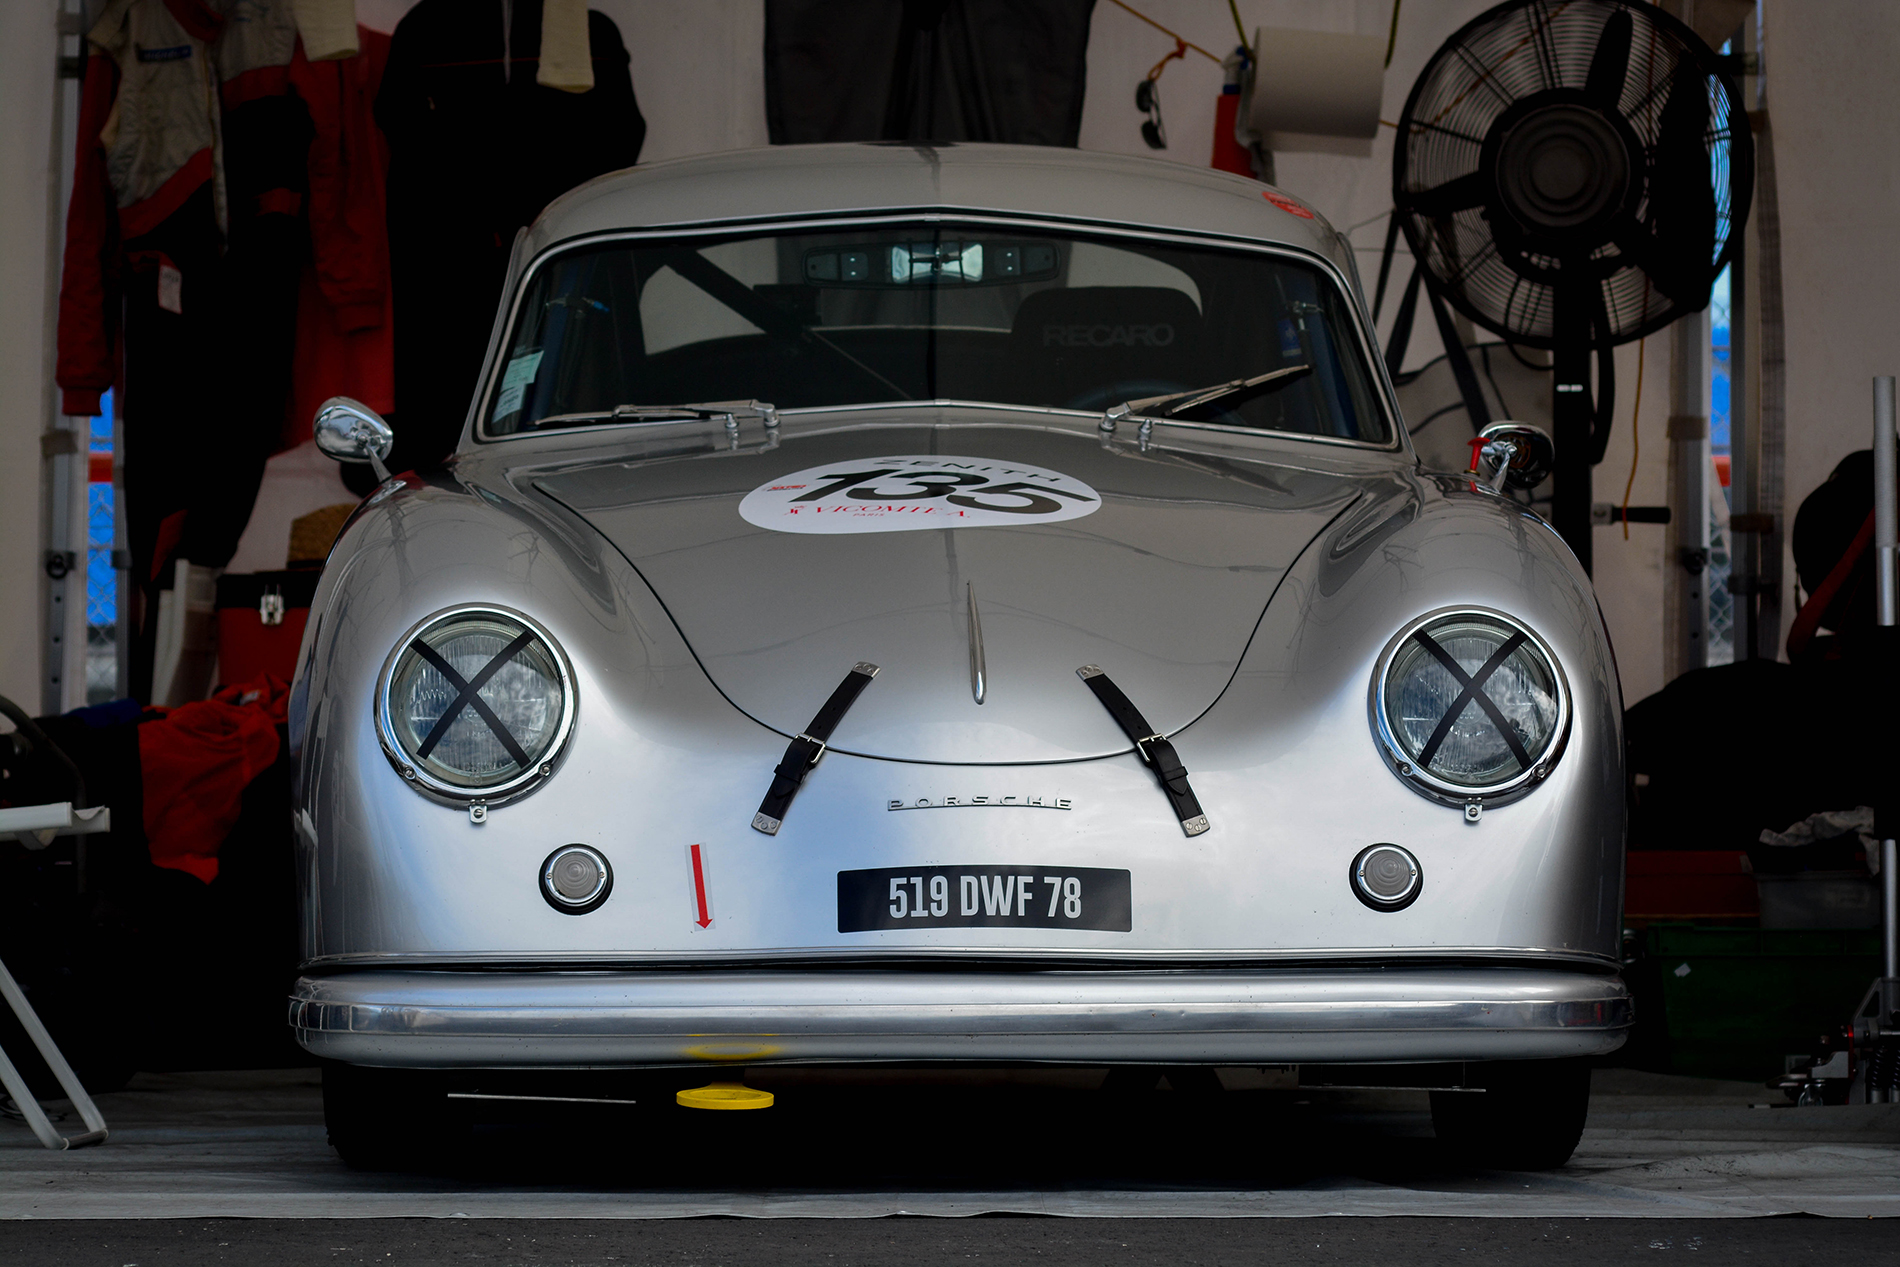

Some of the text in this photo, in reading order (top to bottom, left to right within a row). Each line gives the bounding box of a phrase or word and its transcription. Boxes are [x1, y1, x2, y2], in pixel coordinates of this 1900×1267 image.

[1043, 323, 1175, 347] RECARO
[873, 459, 1061, 482] ZENITH
[787, 468, 1098, 514] 135
[816, 505, 944, 515] VICOMTE
[887, 795, 1073, 811] PORSCHE
[889, 875, 1083, 919] 519 DWF 78
